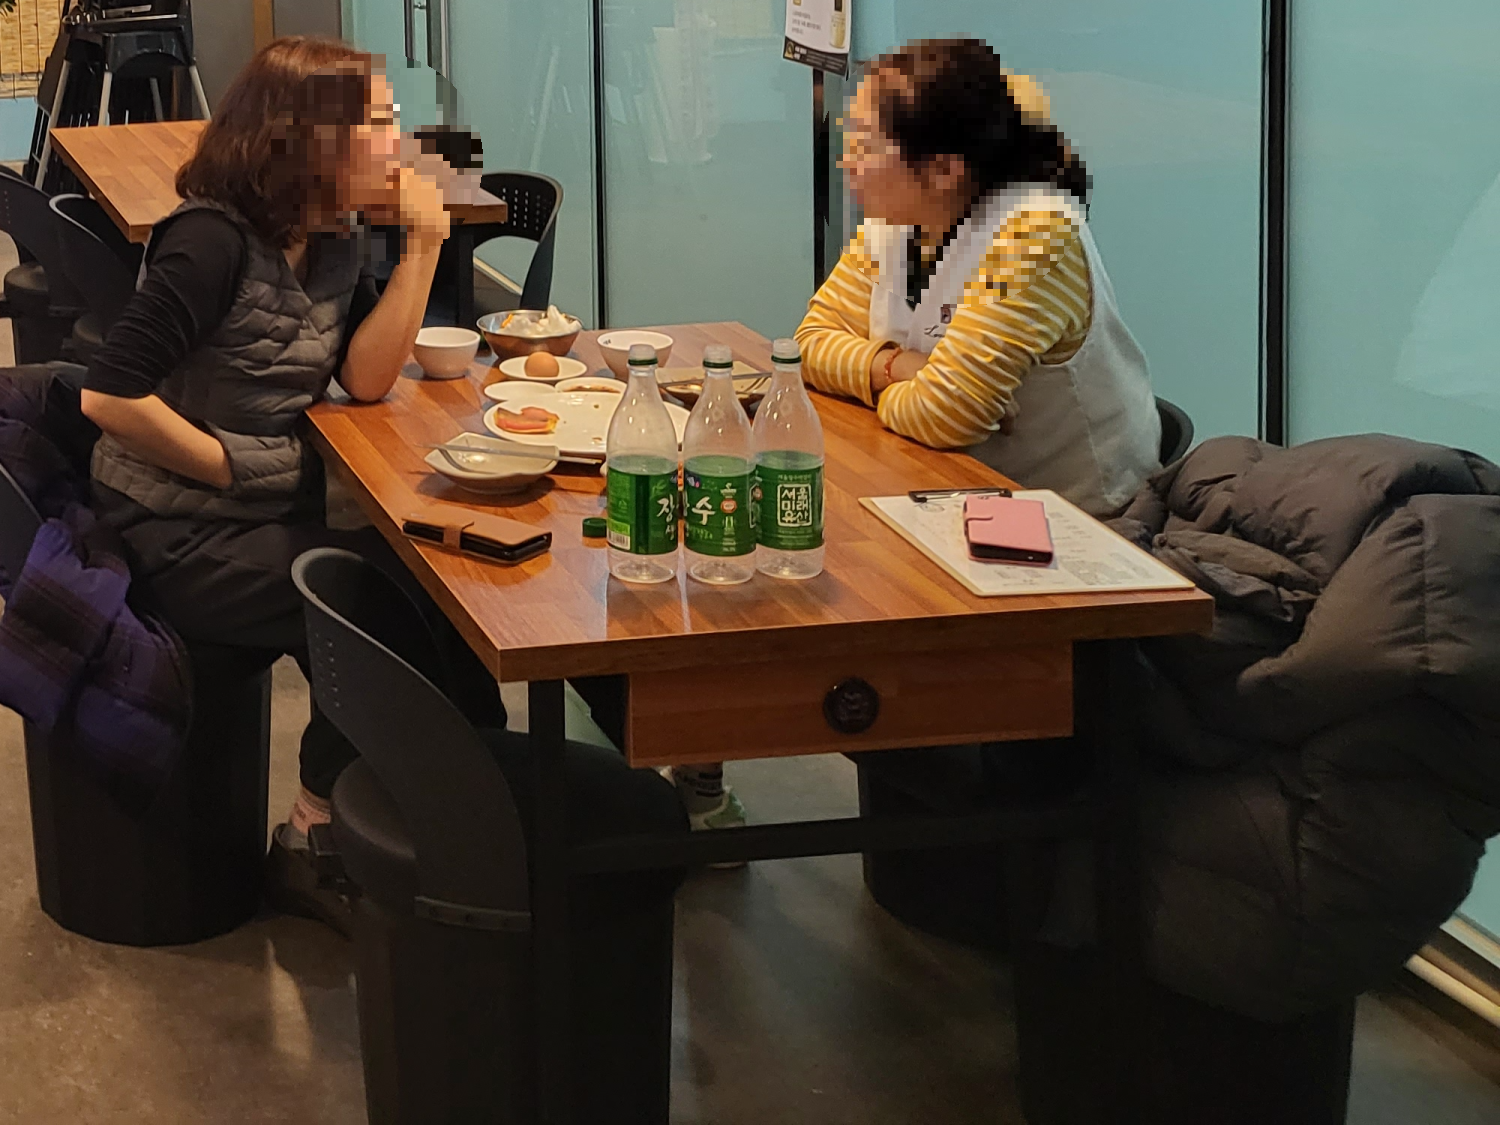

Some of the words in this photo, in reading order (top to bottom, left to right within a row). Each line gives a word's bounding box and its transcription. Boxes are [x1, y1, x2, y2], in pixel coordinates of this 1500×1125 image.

[781, 486, 809, 500] 서울
[781, 499, 809, 511] 미래
[781, 510, 809, 523] 유산
